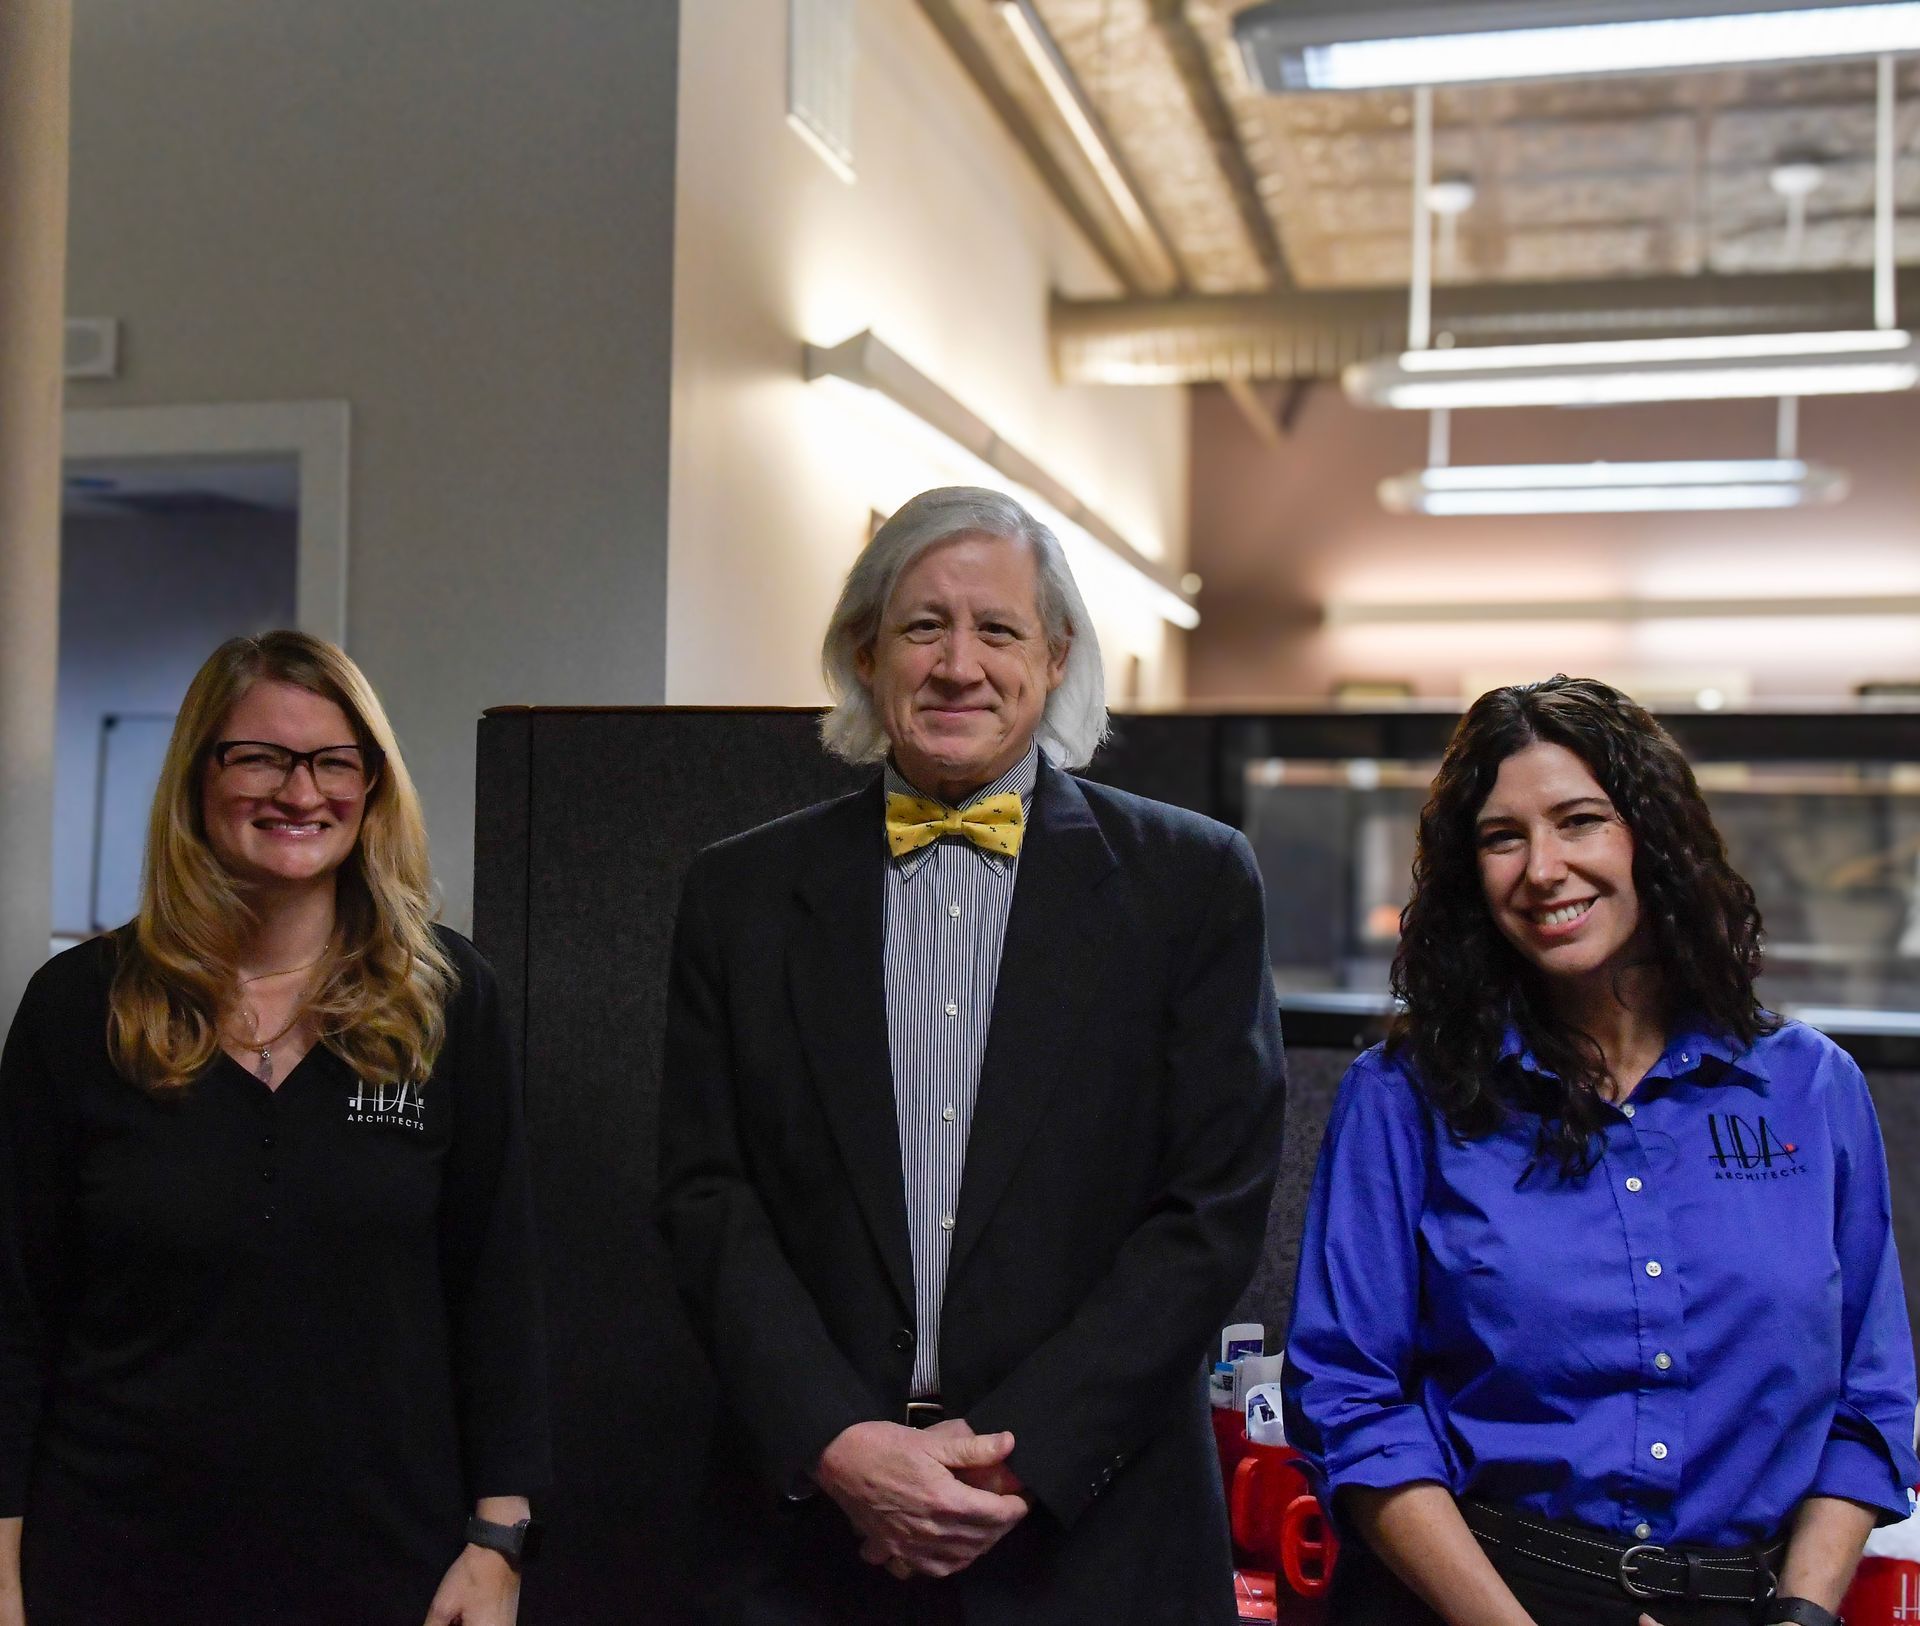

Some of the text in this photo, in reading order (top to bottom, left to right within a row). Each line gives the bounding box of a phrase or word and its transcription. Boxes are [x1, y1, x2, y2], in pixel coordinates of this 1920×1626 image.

[347, 1114, 424, 1131] ARCHITECTS
[1708, 1114, 1797, 1168] HDA
[1715, 1165, 1808, 1180] ARCHITECTS
